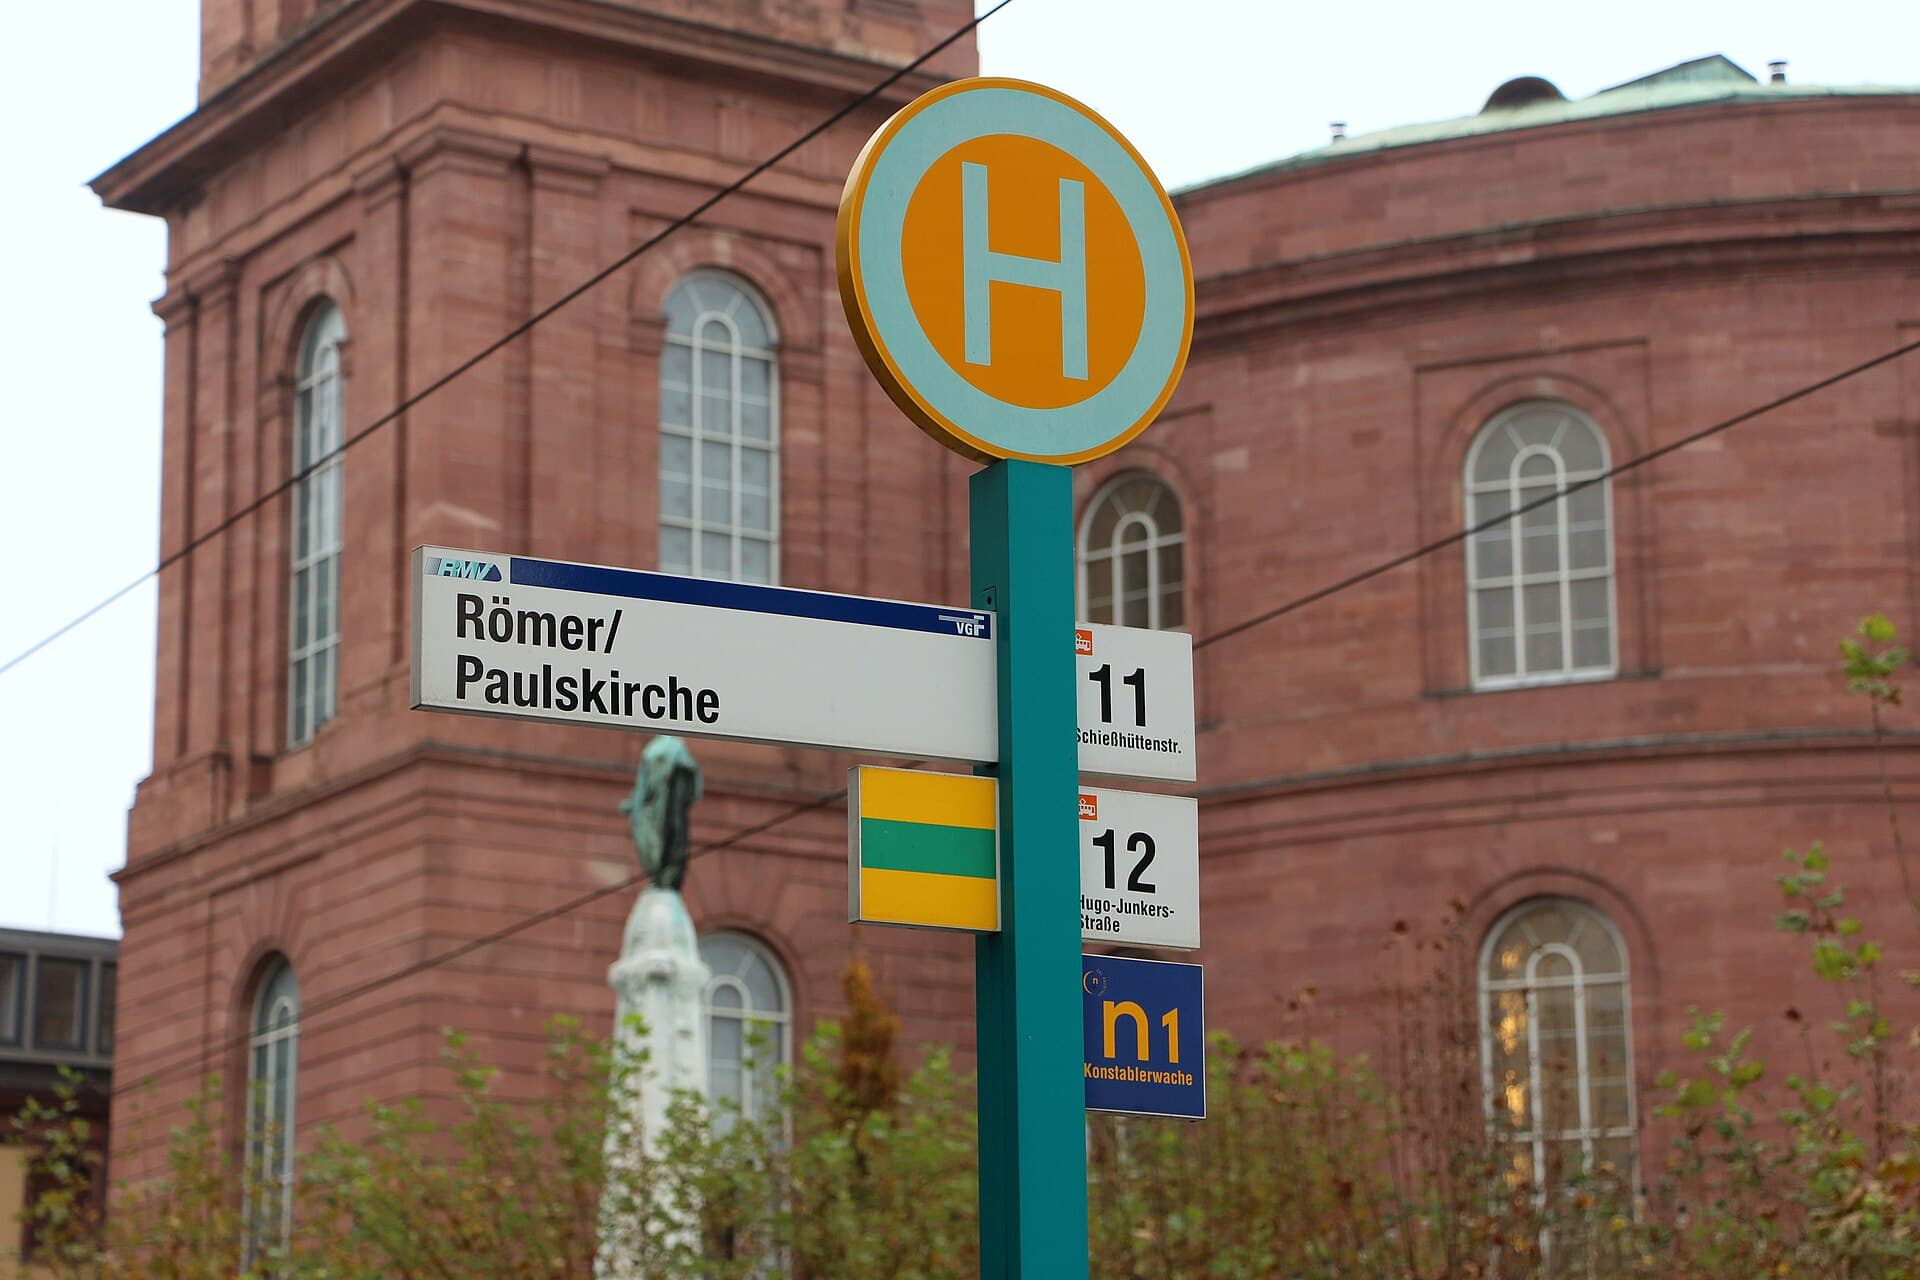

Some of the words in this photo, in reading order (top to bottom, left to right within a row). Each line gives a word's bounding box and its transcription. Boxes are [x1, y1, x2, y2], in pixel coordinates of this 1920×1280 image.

[962, 161, 1088, 380] H
[438, 559, 494, 580] RMV
[456, 594, 622, 654] Römer/
[956, 615, 985, 636] VGF
[456, 655, 720, 724] Paulskirche
[1089, 664, 1146, 727] 11
[1076, 728, 1182, 754] Schießhüttenstr.
[1092, 829, 1156, 893] 12
[1084, 1062, 1193, 1086] Konstablerwache
